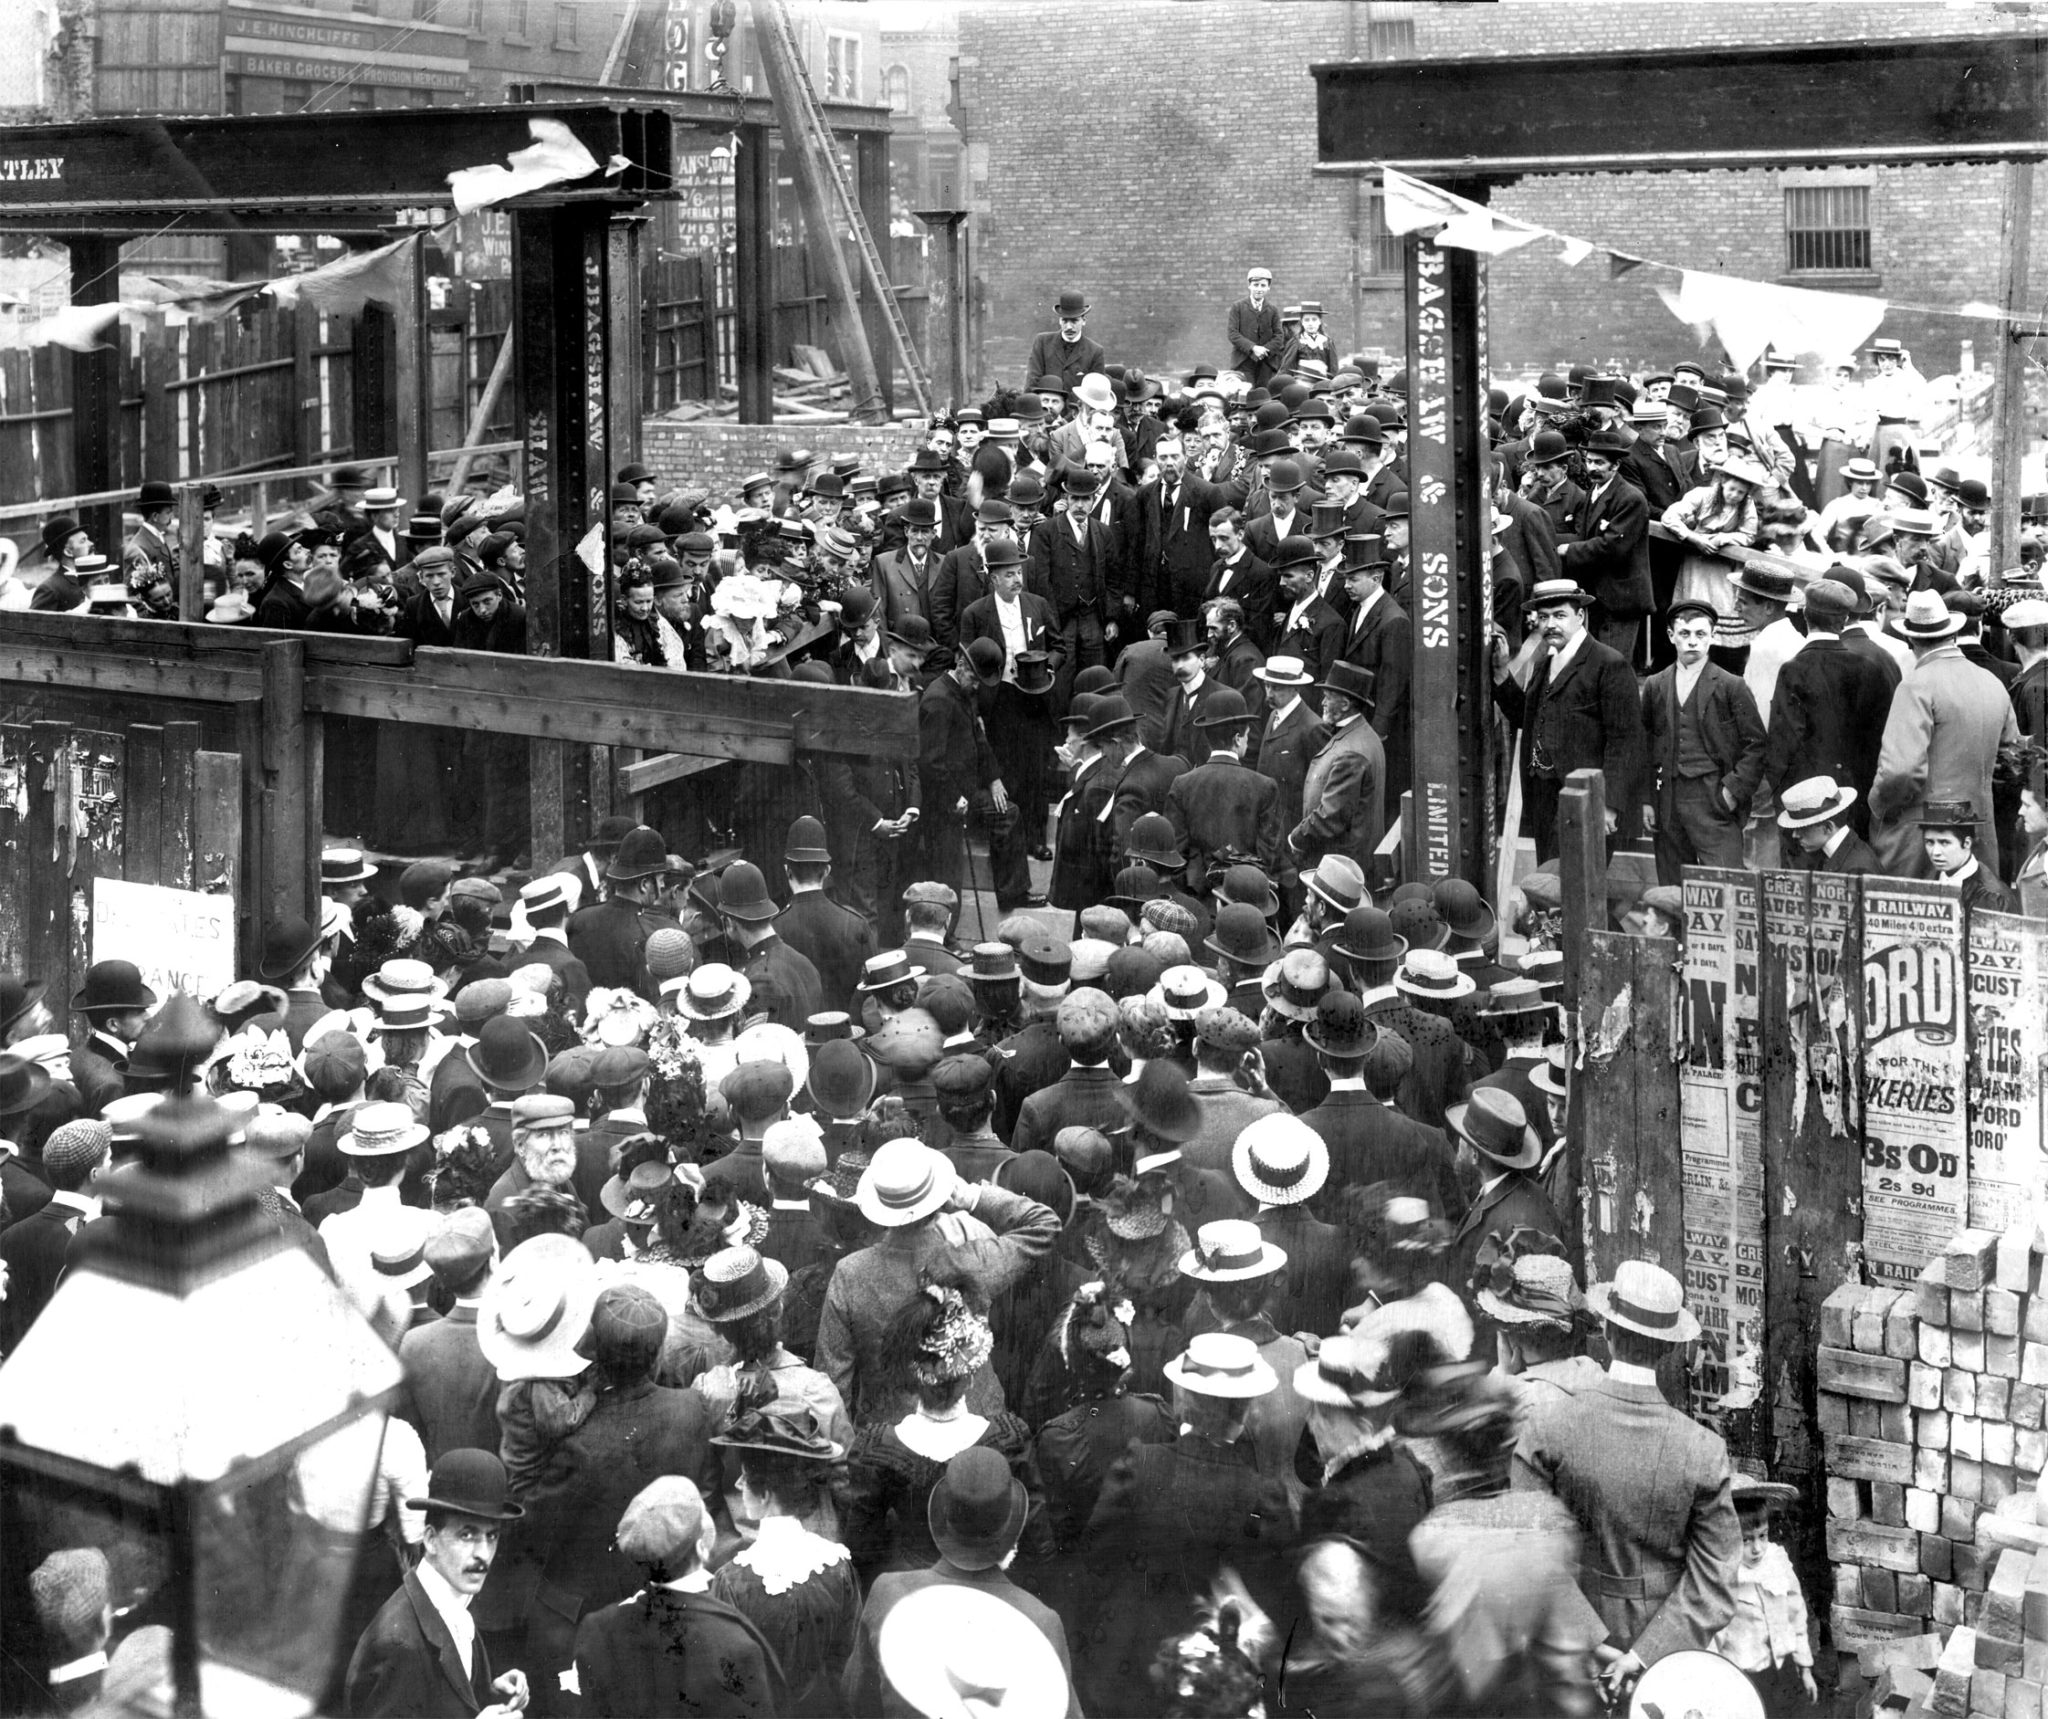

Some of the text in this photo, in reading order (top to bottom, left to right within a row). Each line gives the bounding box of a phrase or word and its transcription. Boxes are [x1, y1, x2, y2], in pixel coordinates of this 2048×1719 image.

[267, 22, 361, 45] HINCHLIFFE
[0, 158, 64, 180] TLEY
[679, 207, 711, 218] PERIAL
[593, 573, 606, 637] ONS
[1423, 552, 1449, 648] SONS
[1427, 782, 1449, 877] LIMITED
[1686, 886, 1719, 908] WAY
[1765, 879, 1803, 897] GREA
[1878, 900, 1951, 918] RAILWAY.
[1882, 918, 1907, 930] Miles
[1927, 923, 1953, 935] extra
[1736, 929, 1757, 951] SA
[1866, 1076, 1955, 1114] KERIES
[1868, 1194, 1885, 1203] SEE
[1879, 1177, 1935, 1198] 2s 9d
